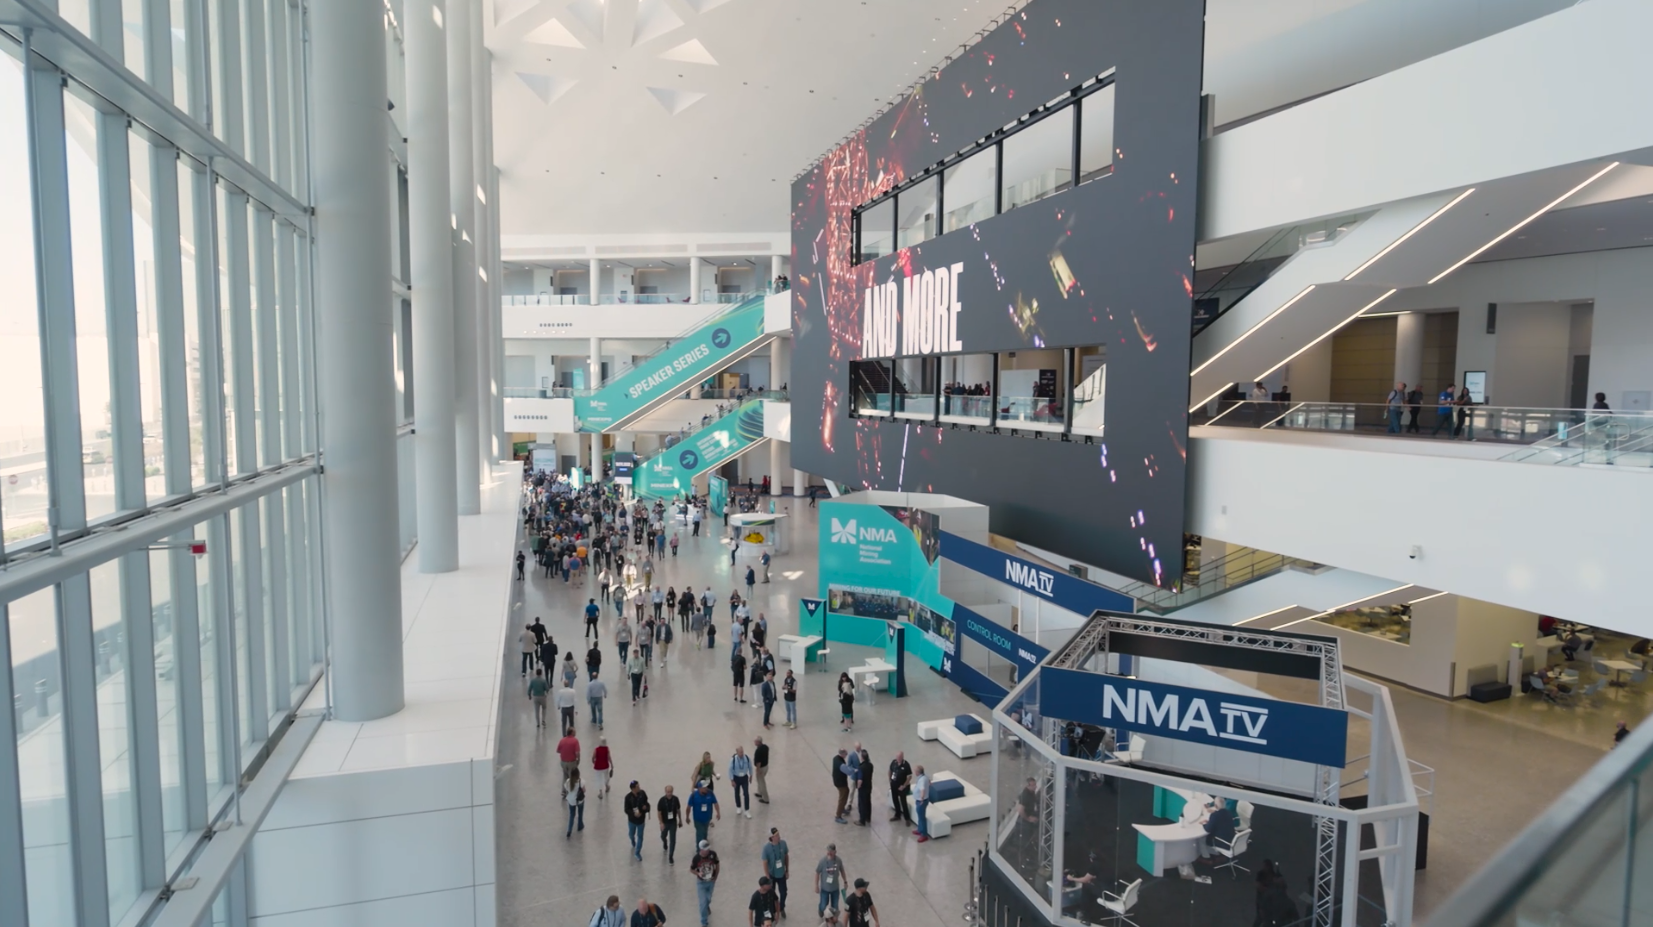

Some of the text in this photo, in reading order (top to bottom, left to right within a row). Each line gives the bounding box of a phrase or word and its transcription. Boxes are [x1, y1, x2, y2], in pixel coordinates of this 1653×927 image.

[862, 262, 964, 359] AND MORE
[629, 344, 710, 398] SPEAKER SERIES
[859, 526, 898, 543] NMA
[851, 585, 863, 594] FOR
[864, 586, 877, 595] OUR
[877, 588, 901, 597] FUTURE
[966, 619, 1012, 651] CONTROL ROOM
